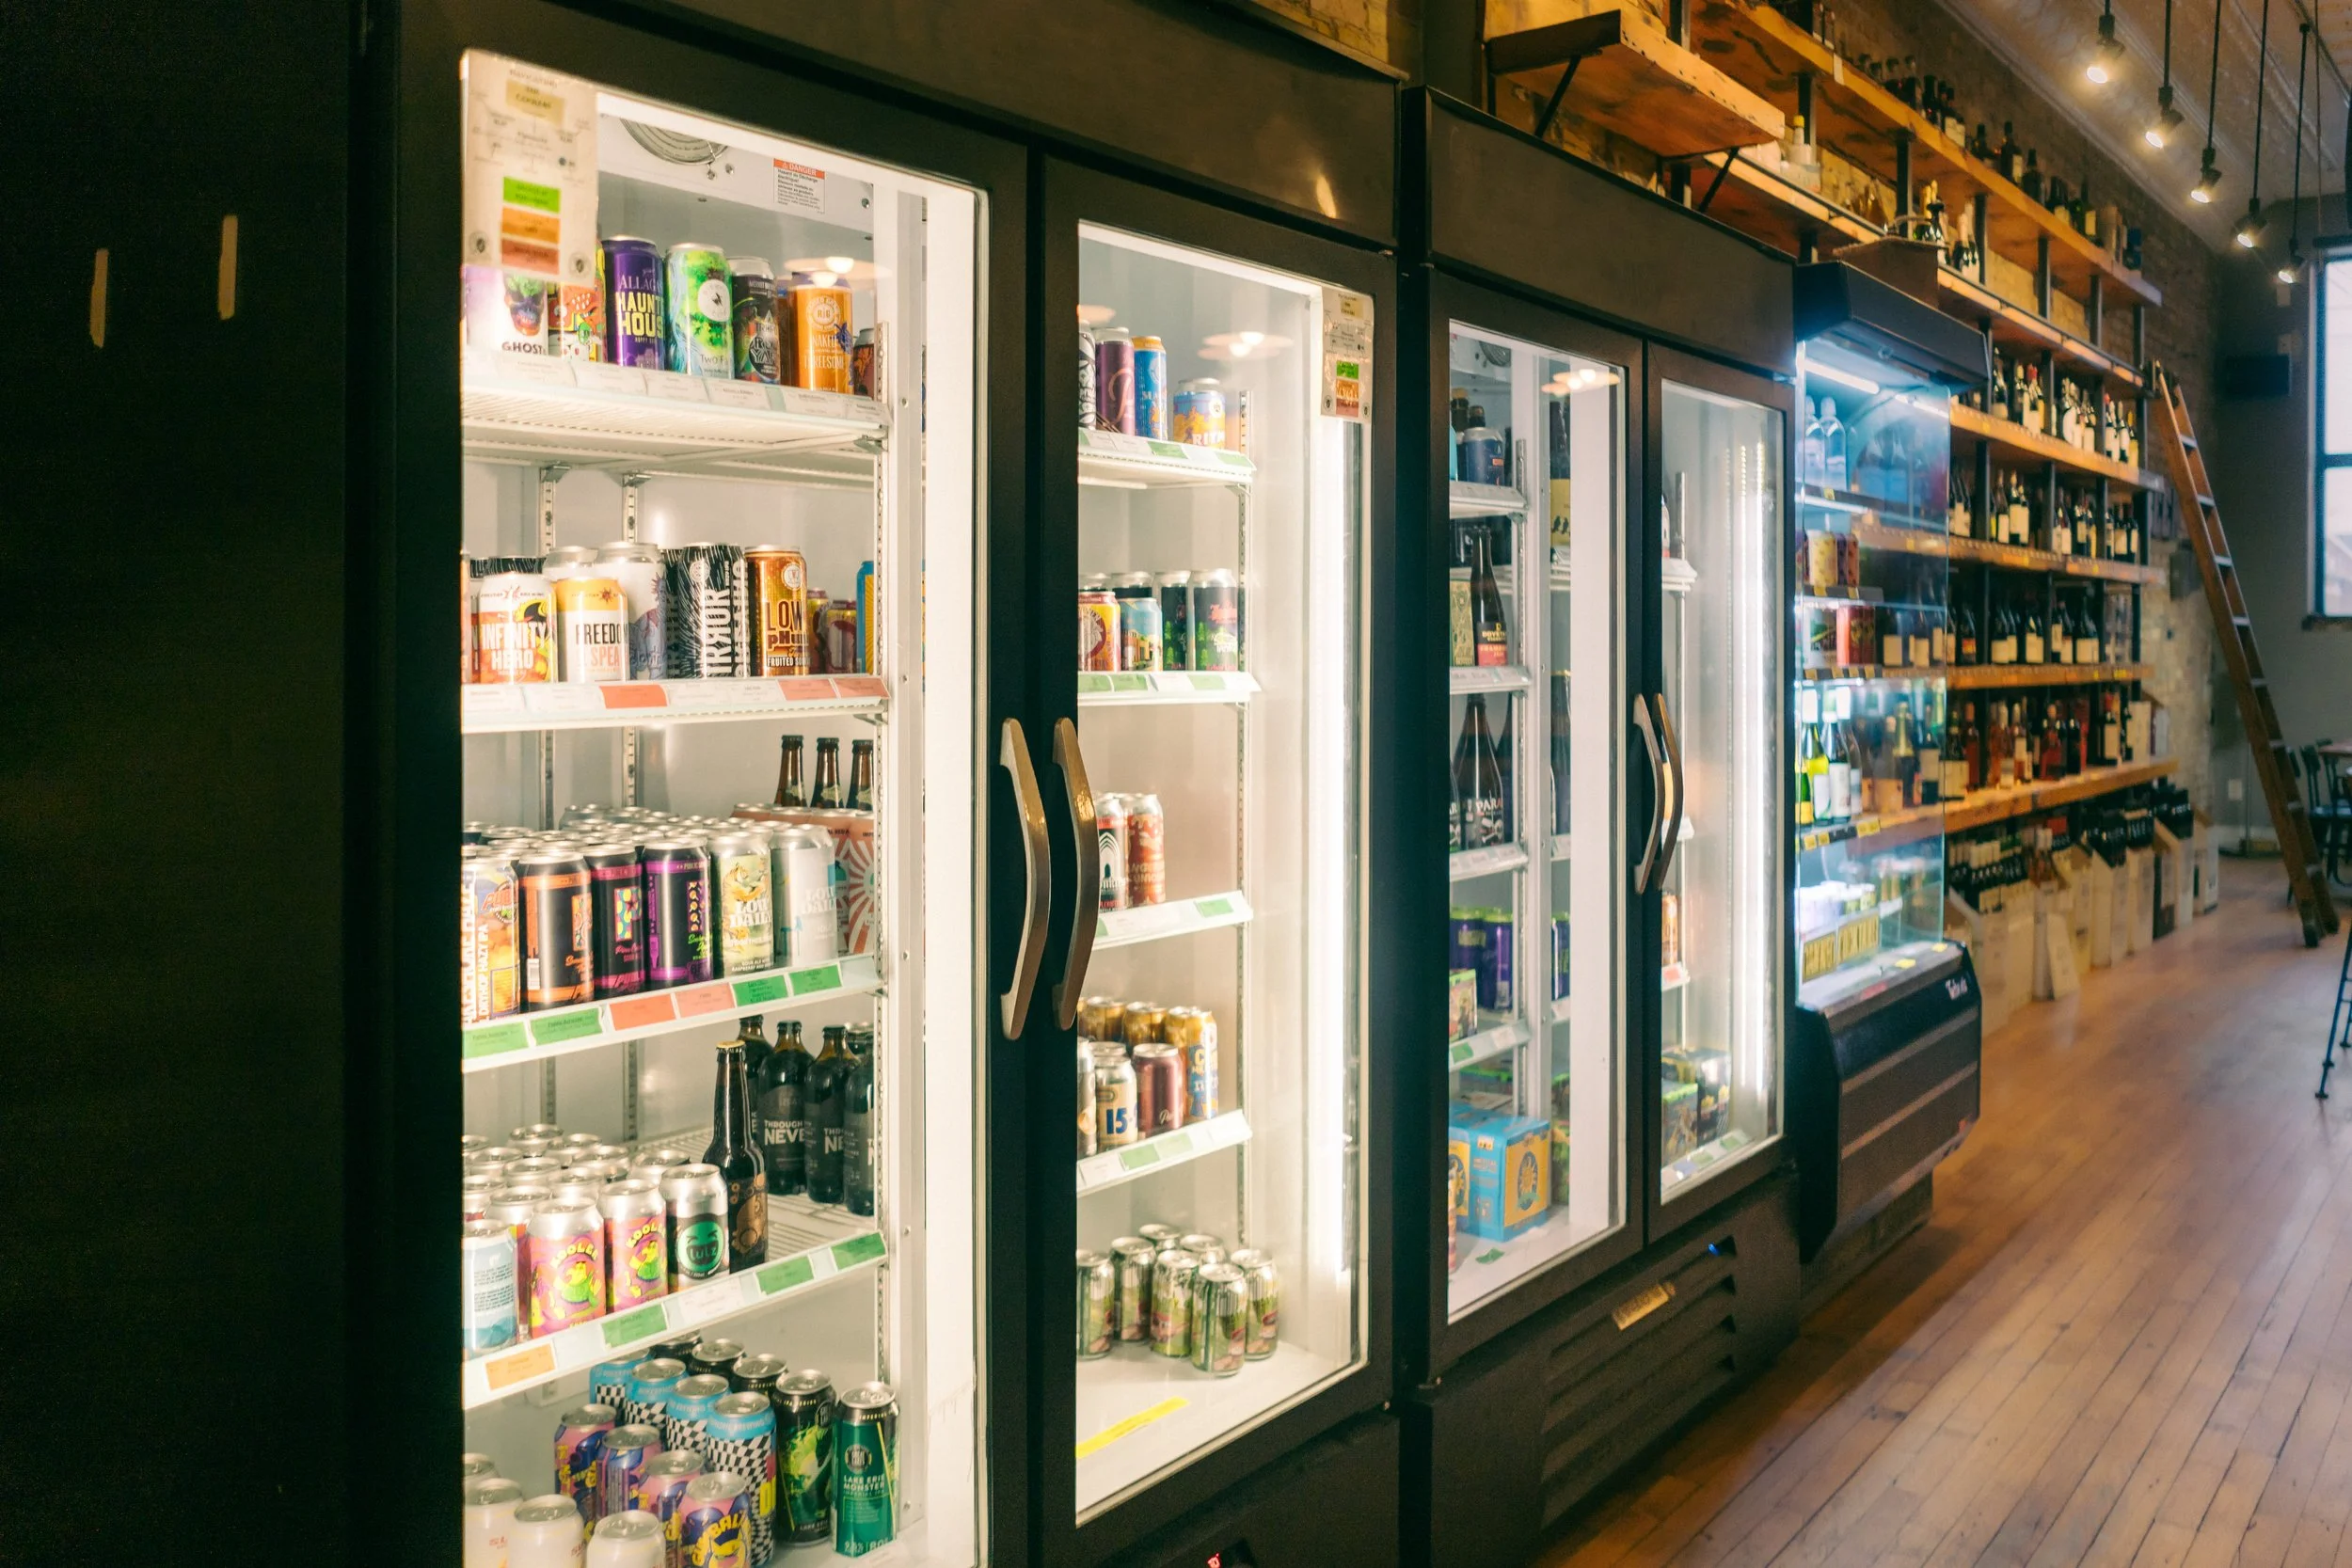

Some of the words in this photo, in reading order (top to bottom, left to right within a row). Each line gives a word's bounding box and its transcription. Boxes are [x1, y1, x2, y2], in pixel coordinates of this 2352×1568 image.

[788, 163, 817, 177] DANGER
[616, 311, 664, 340] HOUS
[812, 333, 838, 348] NAKED
[766, 600, 803, 633] LOW
[481, 621, 548, 649] INFINITY
[491, 649, 534, 670] HERO
[767, 657, 794, 667] FRUITED
[764, 1119, 803, 1129] THROUGH
[1105, 1108, 1128, 1134] 15
[764, 1128, 805, 1146] NEVE
[843, 1482, 885, 1492] MONSTER
